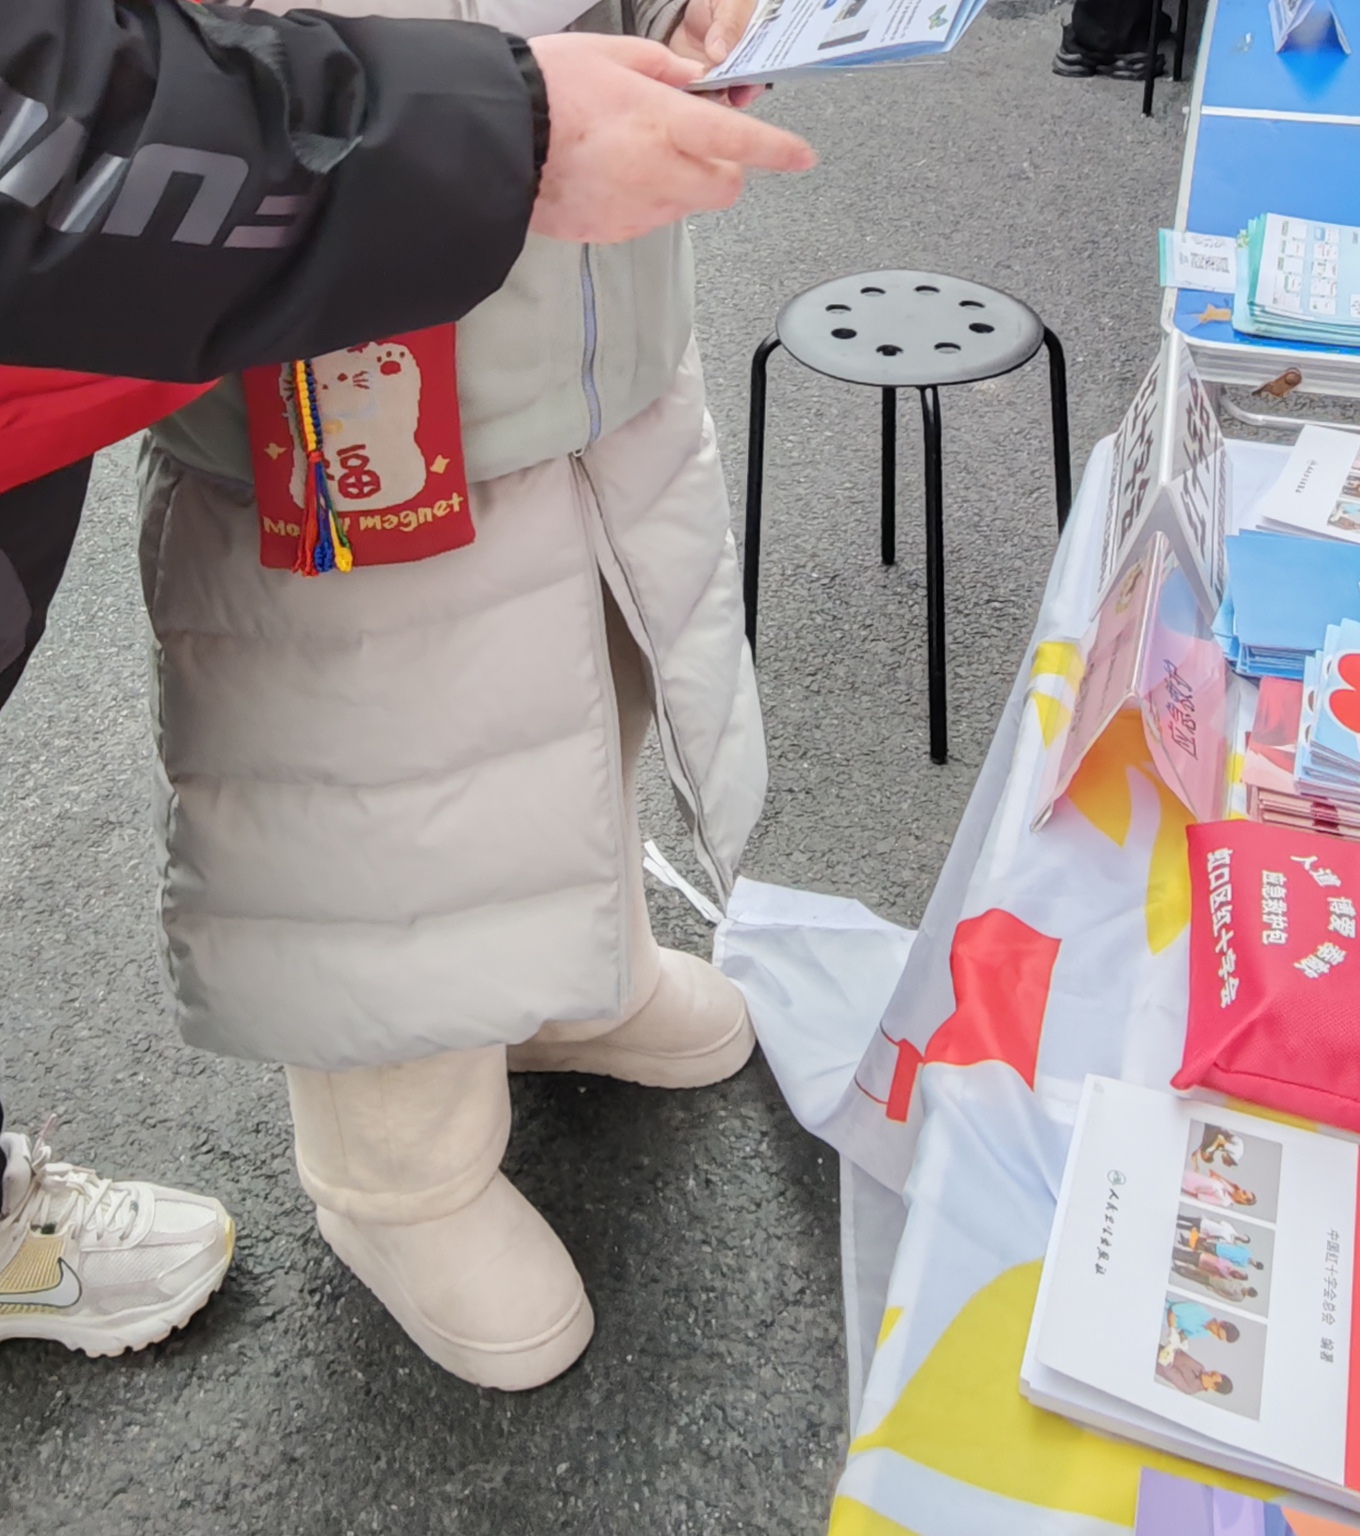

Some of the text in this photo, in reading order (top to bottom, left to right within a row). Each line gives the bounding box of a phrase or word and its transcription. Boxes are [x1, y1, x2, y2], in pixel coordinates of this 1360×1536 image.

[358, 492, 464, 531] magnet
[1166, 658, 1204, 761] 应急救护
[1207, 848, 1240, 1009] 虹口区红十字会
[1261, 870, 1289, 946] 应急救护包
[1291, 854, 1341, 889] 人道
[1326, 895, 1357, 940] 博爱
[1322, 1229, 1341, 1326] 中国红十字会总会
